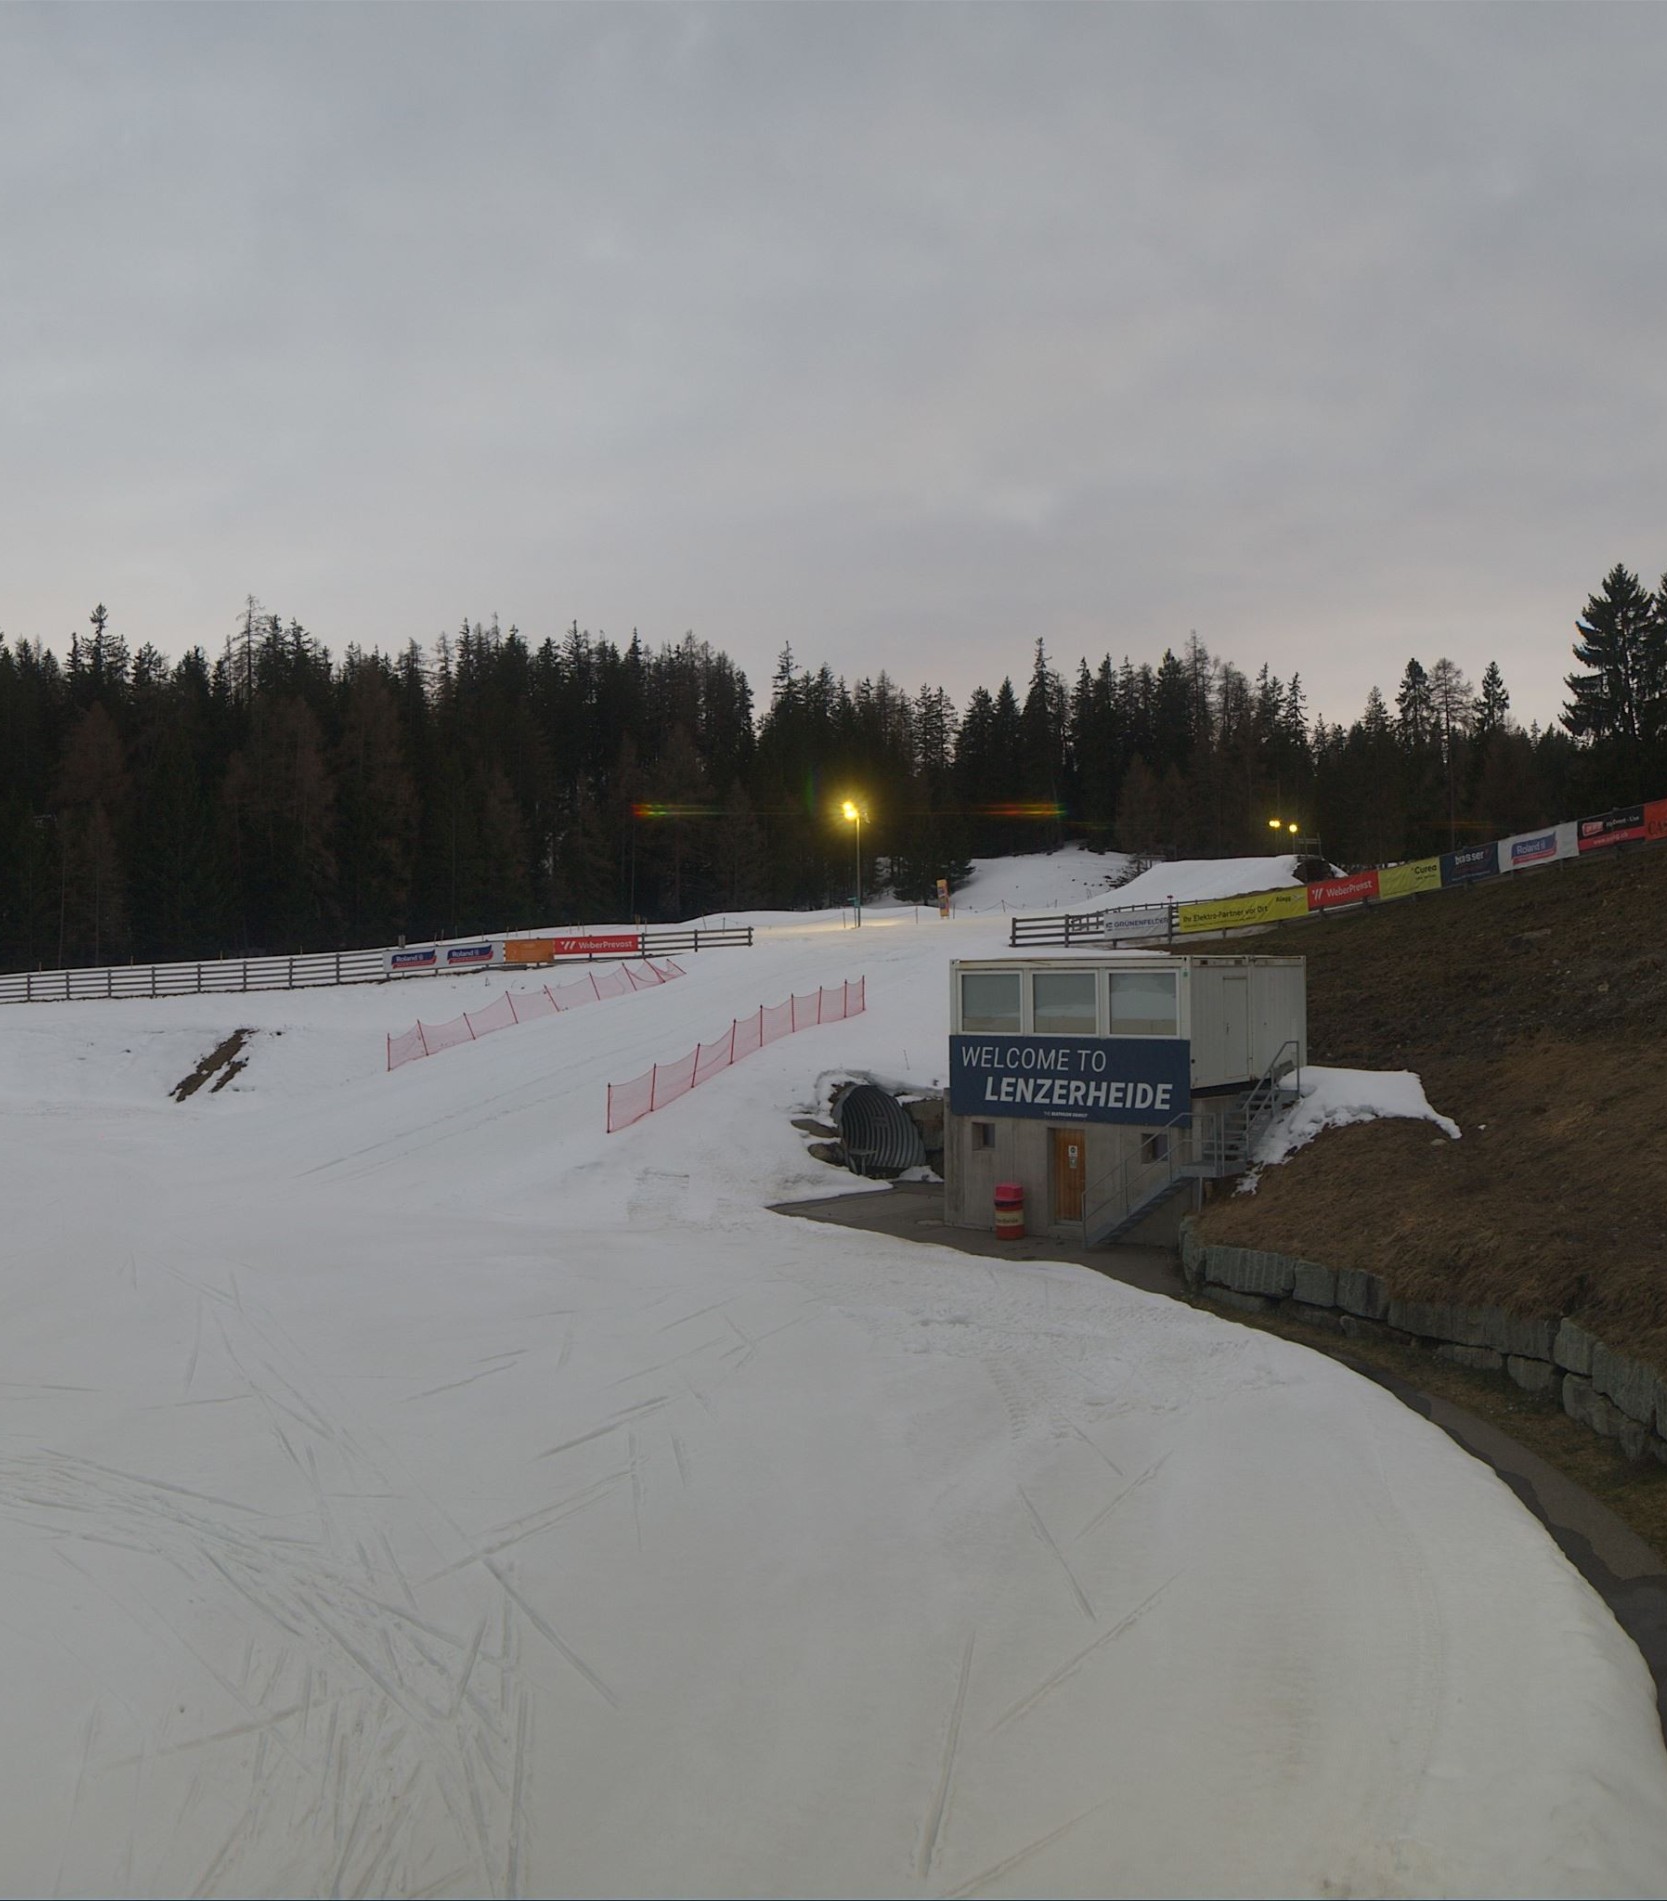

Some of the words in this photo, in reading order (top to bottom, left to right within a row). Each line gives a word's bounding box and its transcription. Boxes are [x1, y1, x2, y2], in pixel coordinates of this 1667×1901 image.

[1516, 843, 1540, 855] Roland
[396, 954, 417, 963] Roland
[452, 949, 473, 957] Roland
[961, 1046, 1070, 1071] WELCOME
[1077, 1050, 1106, 1072] TO
[984, 1076, 1173, 1110] LENZERHEIDE
